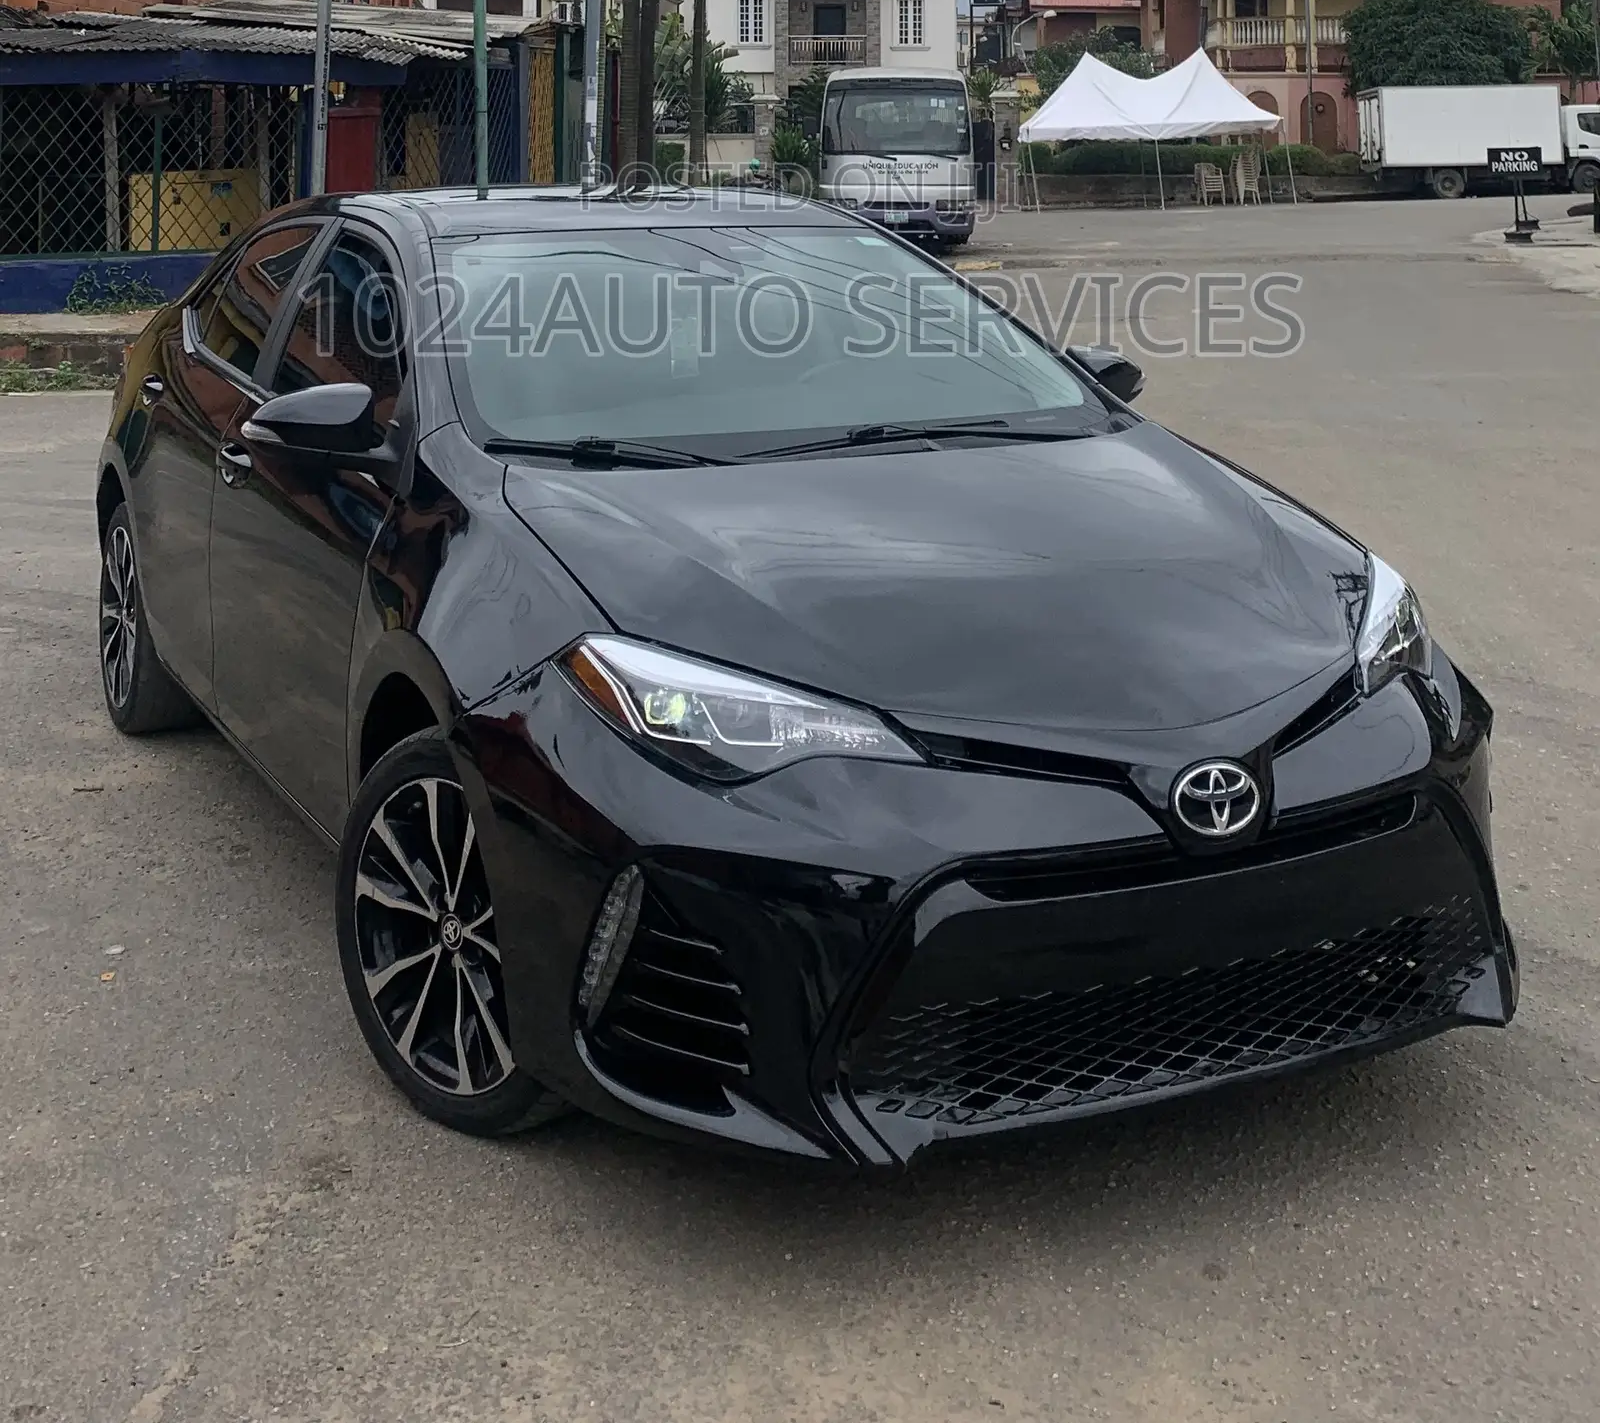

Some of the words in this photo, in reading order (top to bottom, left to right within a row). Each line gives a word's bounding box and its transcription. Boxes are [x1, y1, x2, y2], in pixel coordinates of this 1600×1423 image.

[1500, 151, 1529, 161] NO
[862, 162, 891, 170] UNIQUE
[894, 162, 939, 170] EDUCATION
[1491, 161, 1538, 172] PARKING
